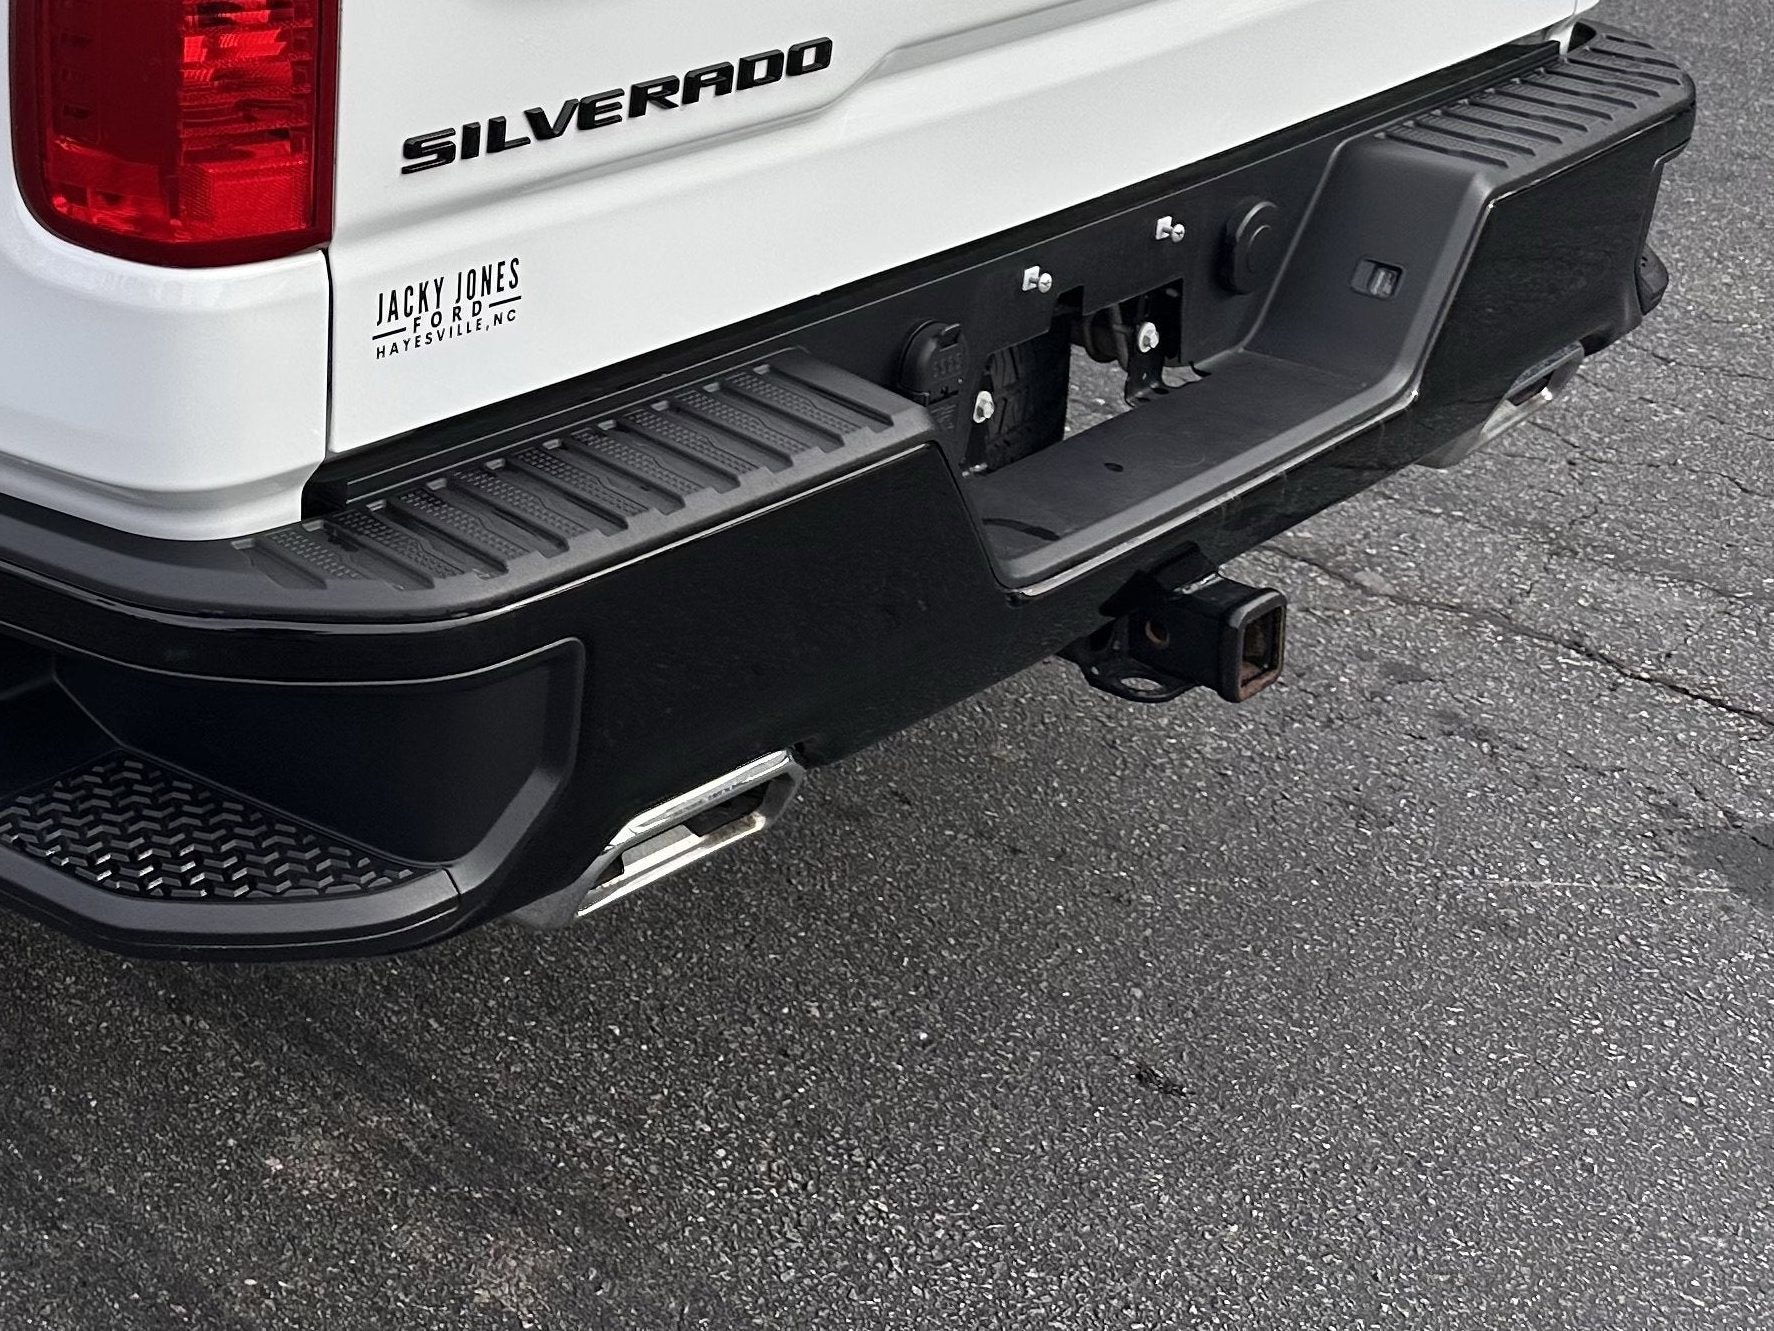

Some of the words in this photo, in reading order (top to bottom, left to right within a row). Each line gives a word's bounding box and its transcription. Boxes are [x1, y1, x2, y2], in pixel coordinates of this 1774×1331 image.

[401, 36, 833, 175] SILVERADO
[376, 276, 444, 327] JACKY
[455, 257, 520, 304] JONES
[413, 300, 483, 334] FORD
